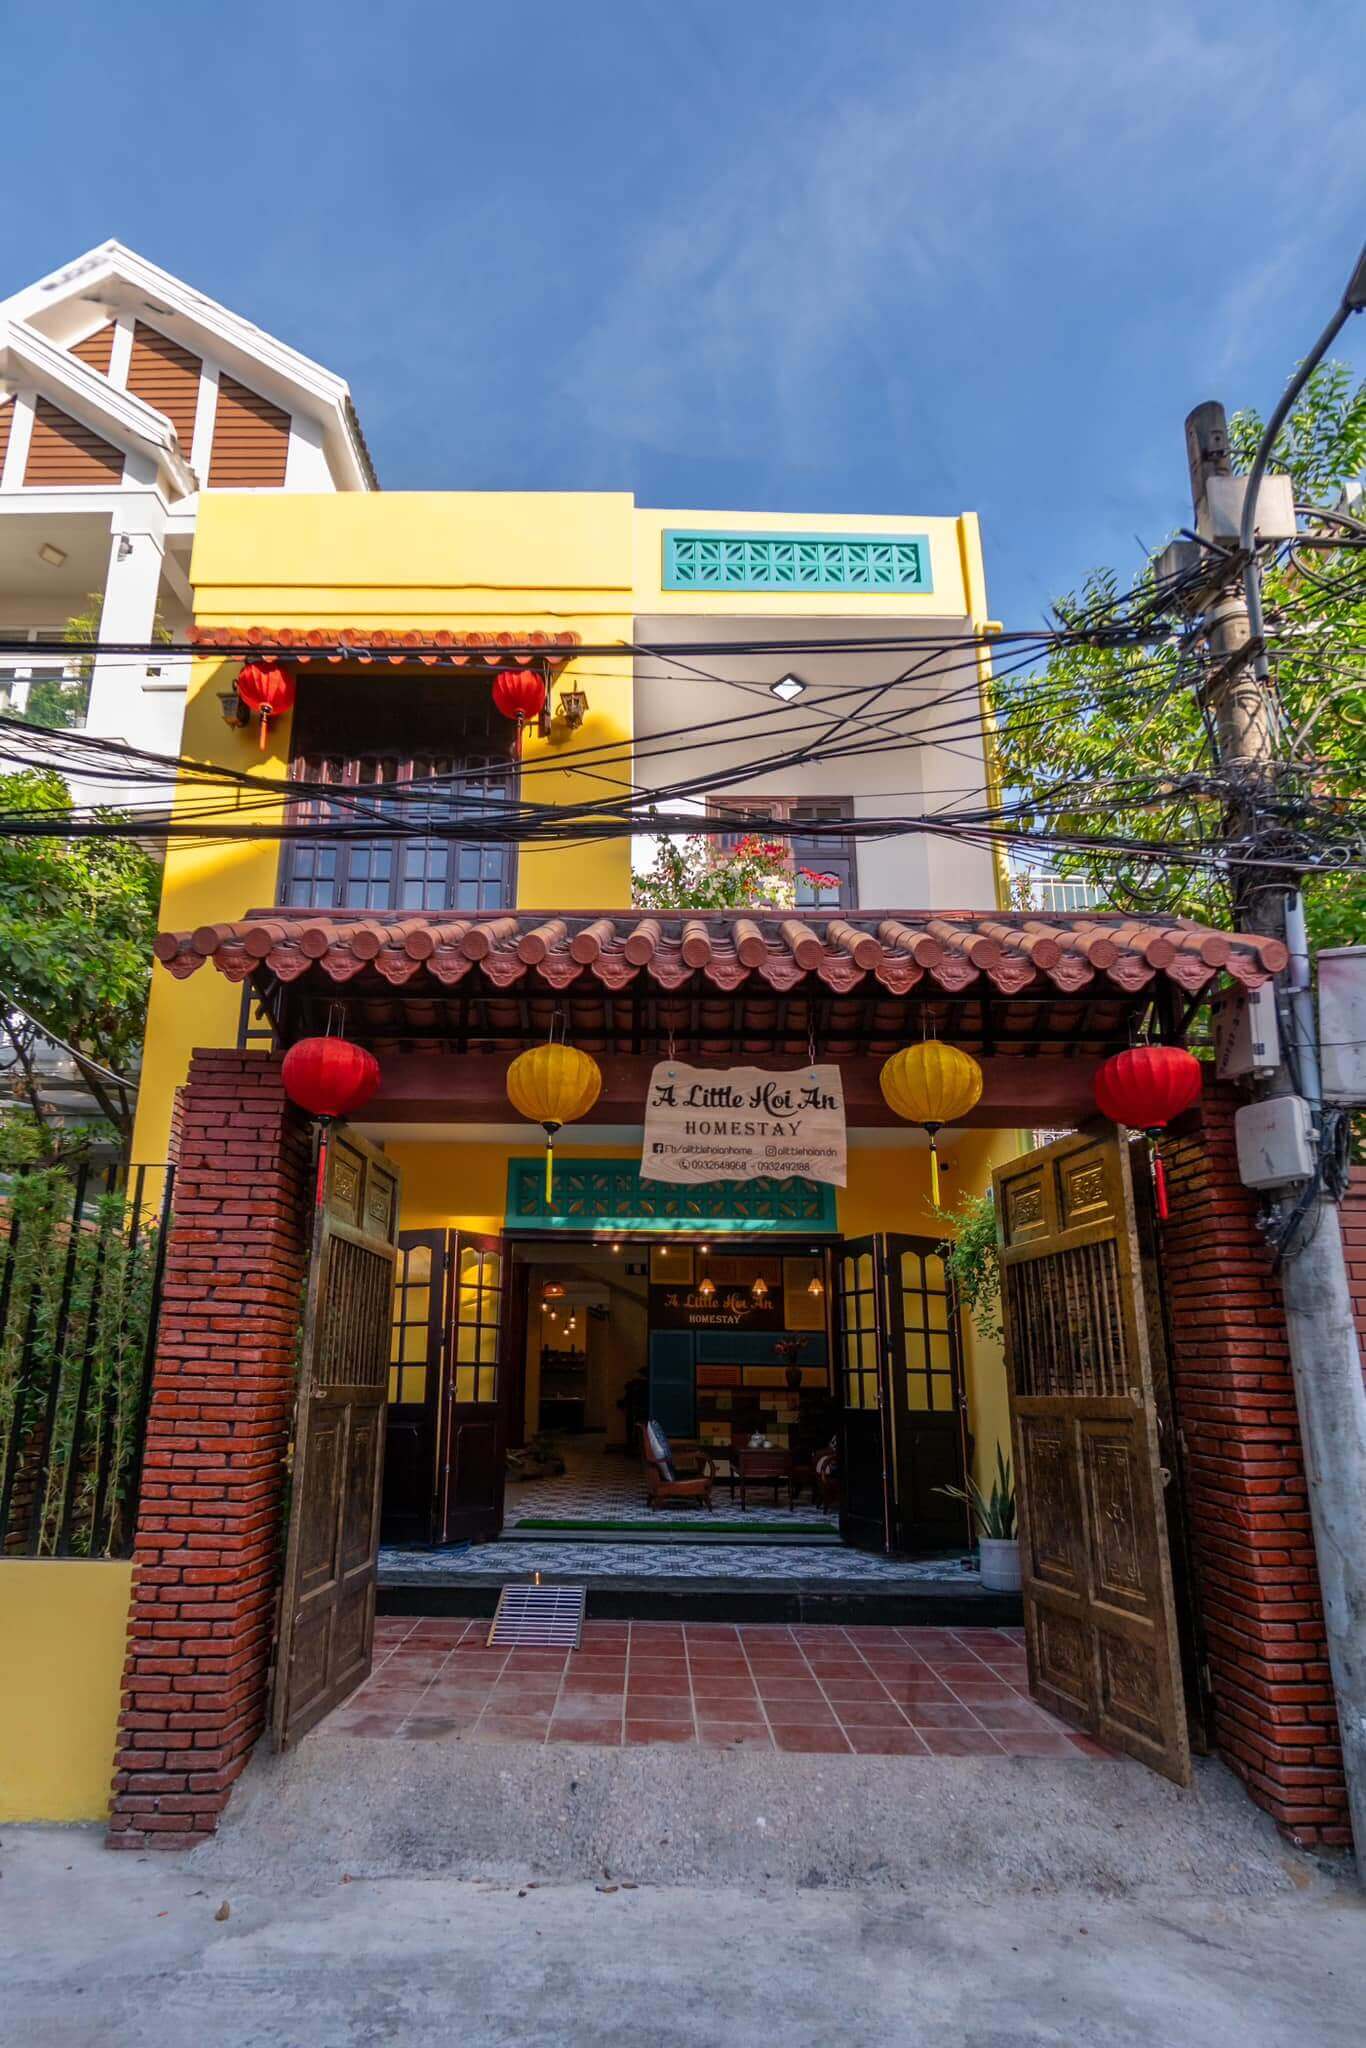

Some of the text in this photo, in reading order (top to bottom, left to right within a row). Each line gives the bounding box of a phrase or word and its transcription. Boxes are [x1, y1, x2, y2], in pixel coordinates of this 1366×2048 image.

[653, 1081, 840, 1118] A Little Hoi An
[686, 1120, 802, 1136] HOMESTAY
[684, 1293, 720, 1309] Little
[722, 1292, 752, 1315] Hoi
[750, 1295, 775, 1311] An
[689, 1314, 742, 1324] HOMESTAY
